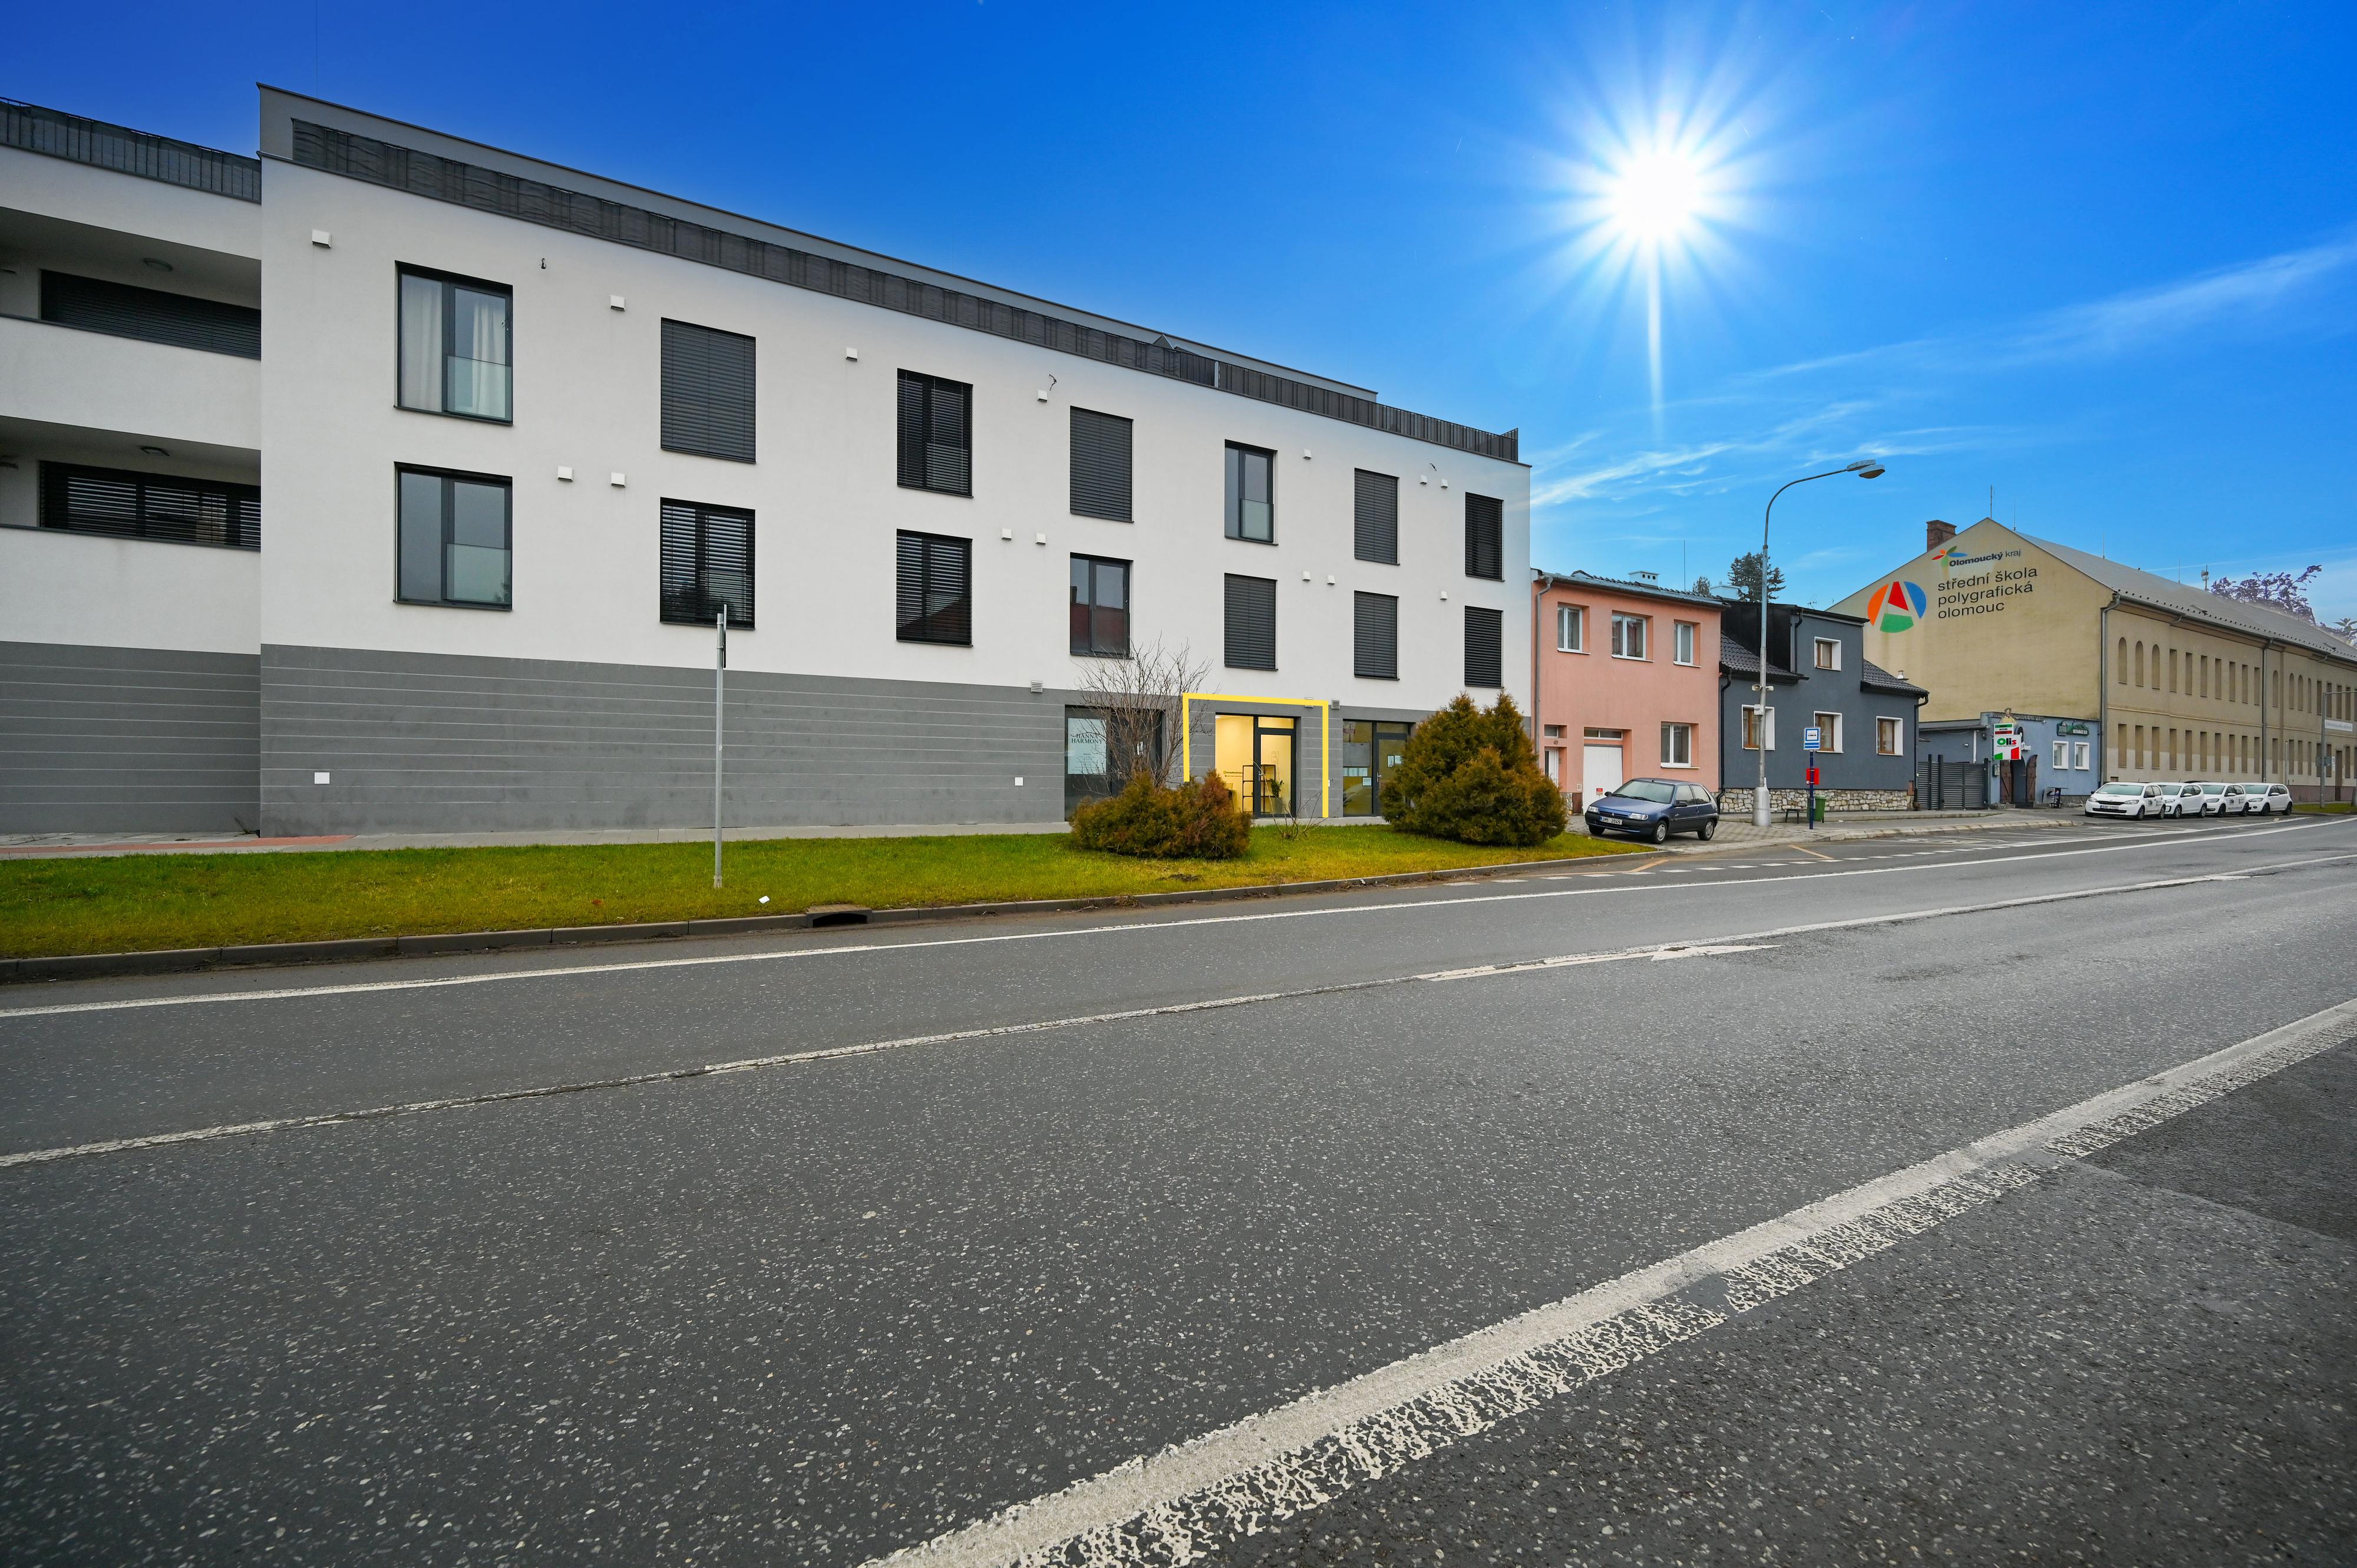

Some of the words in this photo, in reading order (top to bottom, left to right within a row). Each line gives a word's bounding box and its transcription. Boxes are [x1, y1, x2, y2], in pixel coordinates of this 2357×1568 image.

[1949, 552, 2003, 567] Olomoucký
[2005, 549, 2021, 557] kraj
[1937, 572, 1990, 592] střední
[1995, 567, 2038, 582] škola
[1938, 580, 2033, 608] polygrafická
[1938, 602, 2005, 619] olomouc
